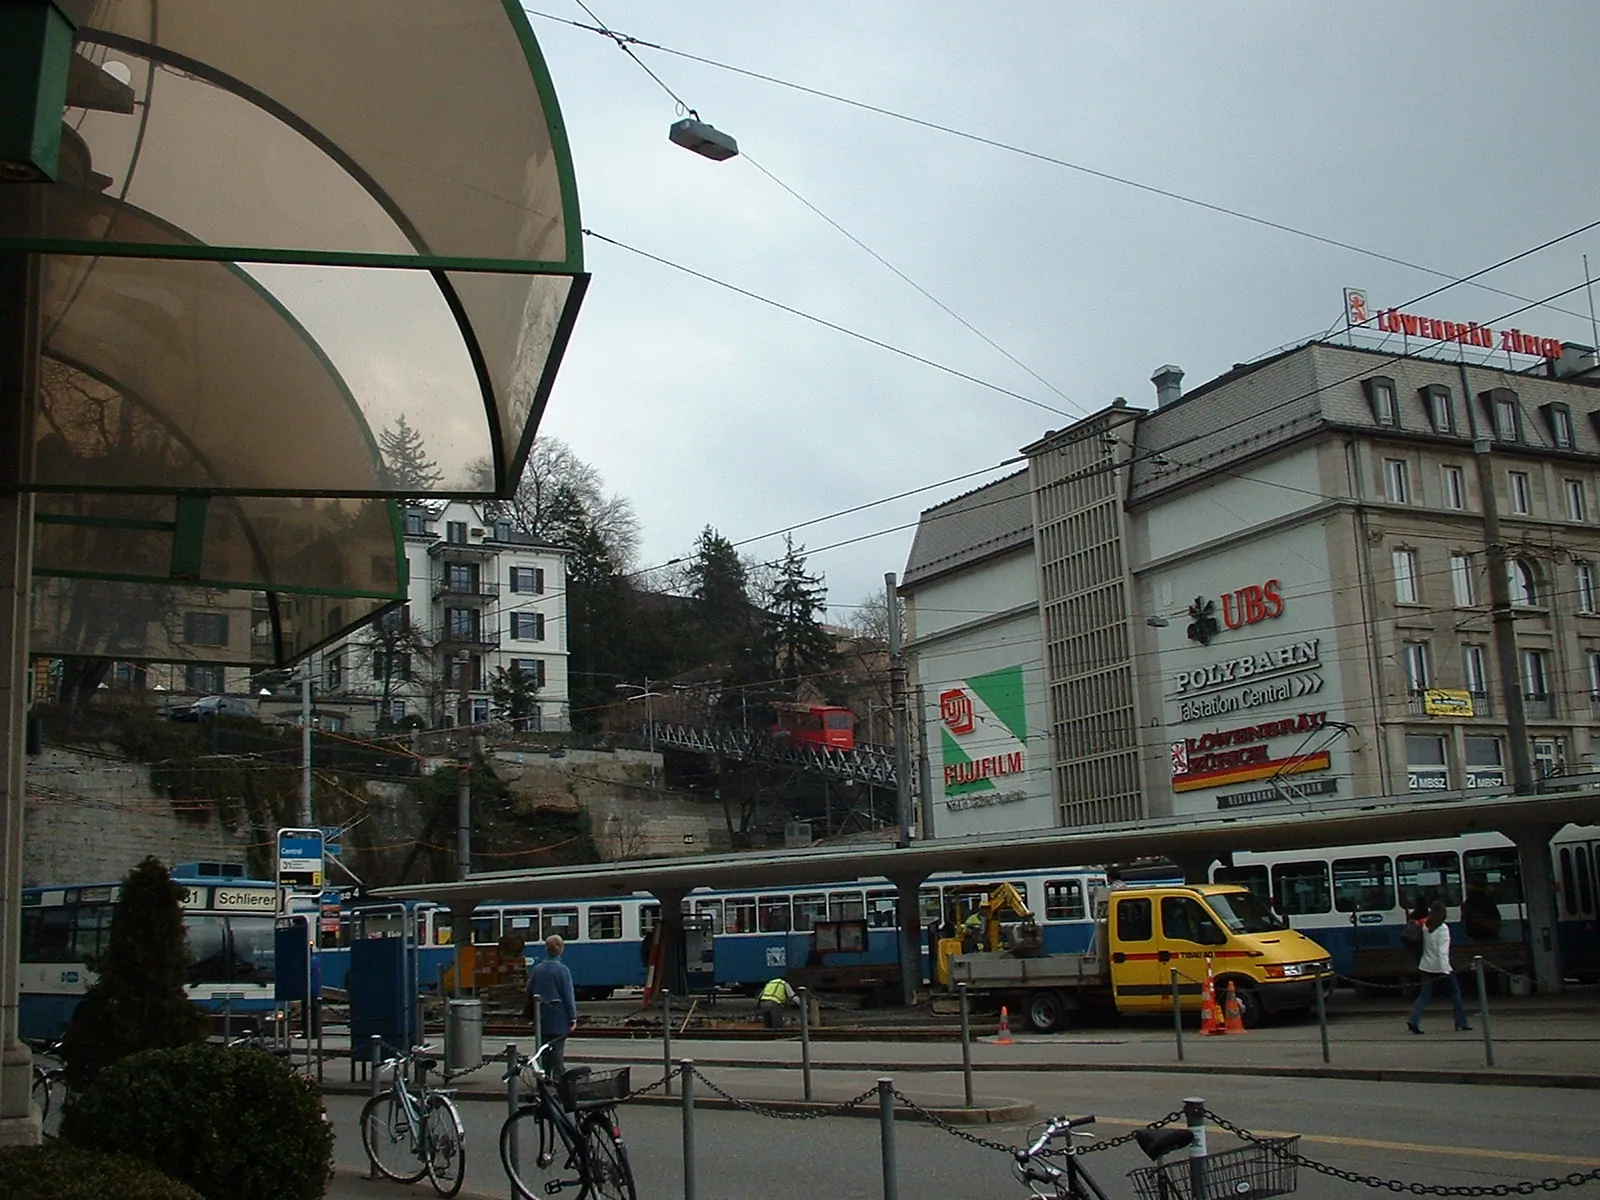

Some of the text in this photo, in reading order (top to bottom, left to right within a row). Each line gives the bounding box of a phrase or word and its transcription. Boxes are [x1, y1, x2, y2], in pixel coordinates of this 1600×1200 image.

[1377, 307, 1562, 359] LÖWENBRÄU ZÜRICH
[1221, 579, 1284, 630] UBS
[1175, 638, 1319, 693] POLYBAHN
[1178, 678, 1292, 721] Talstation Central
[1189, 711, 1326, 753] LÖWENBRÄU
[944, 751, 1025, 787] FUJIFILM
[1189, 745, 1270, 773] ZÜRICH
[280, 847, 303, 855] Central
[282, 861, 292, 870] 31
